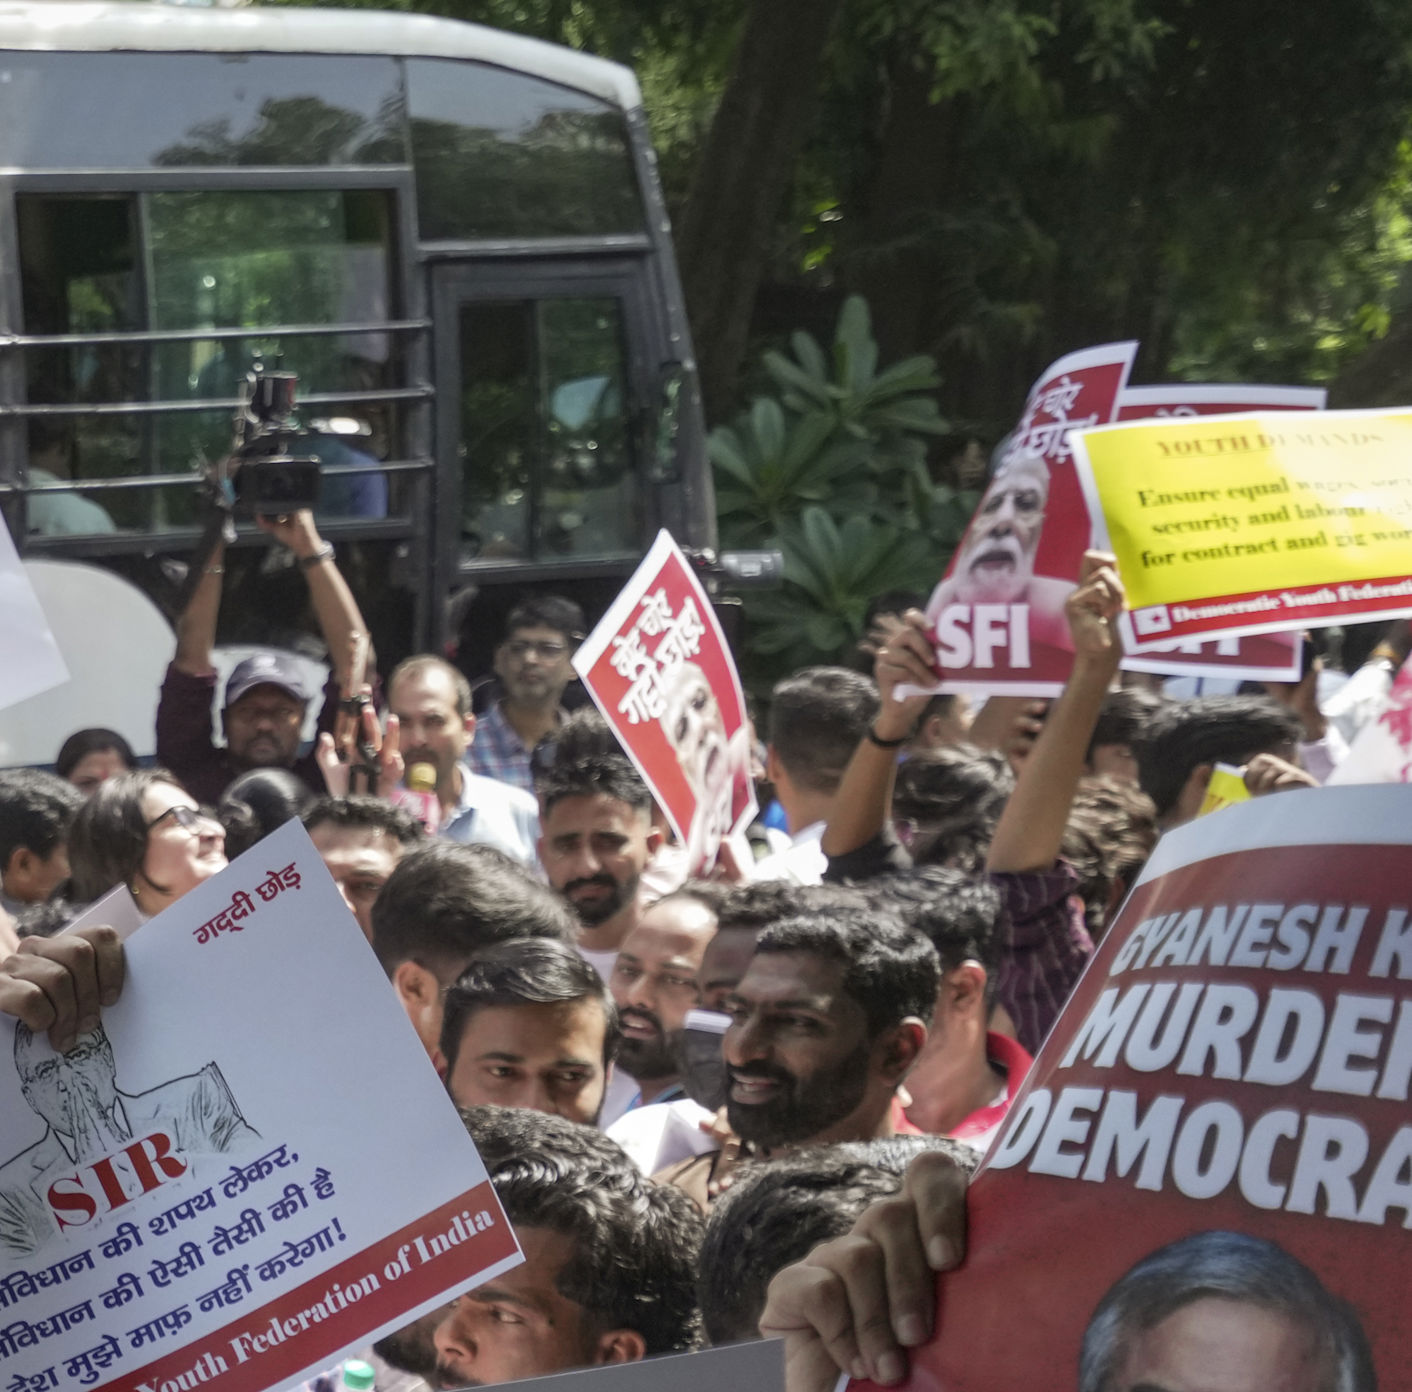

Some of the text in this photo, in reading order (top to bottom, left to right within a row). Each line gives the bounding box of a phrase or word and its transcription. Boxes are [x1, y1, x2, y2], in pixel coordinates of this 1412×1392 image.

[1158, 432, 1250, 458] YOUTH
[1137, 488, 1222, 509] Ensure
[1227, 476, 1289, 503] equal
[1151, 513, 1240, 536] security
[1248, 509, 1290, 527] and
[1141, 549, 1175, 570] for
[1182, 539, 1280, 562] contract
[1286, 530, 1327, 551] and
[937, 602, 1031, 670] SFI
[1171, 593, 1281, 624] Democratic
[1279, 586, 1337, 609] Youth
[254, 861, 304, 906] छोड़
[1108, 903, 1370, 978] GYANESH
[46, 1131, 189, 1235] SIR
[98, 1222, 145, 1262] की
[147, 1186, 217, 1237] शपथ
[218, 1143, 300, 1200] लेकर,
[98, 1272, 146, 1312] की
[147, 1240, 207, 1290] ऐसी
[207, 1207, 267, 1257] तैसी
[267, 1181, 311, 1224] की
[309, 1166, 337, 1201] है
[61, 1334, 124, 1386] मुझे
[126, 1303, 195, 1350] माफ़
[195, 1263, 255, 1314] नहीं
[254, 1216, 348, 1284] करेगा!
[227, 1272, 383, 1365] Federation
[381, 1243, 415, 1283] of
[409, 1207, 497, 1265] India
